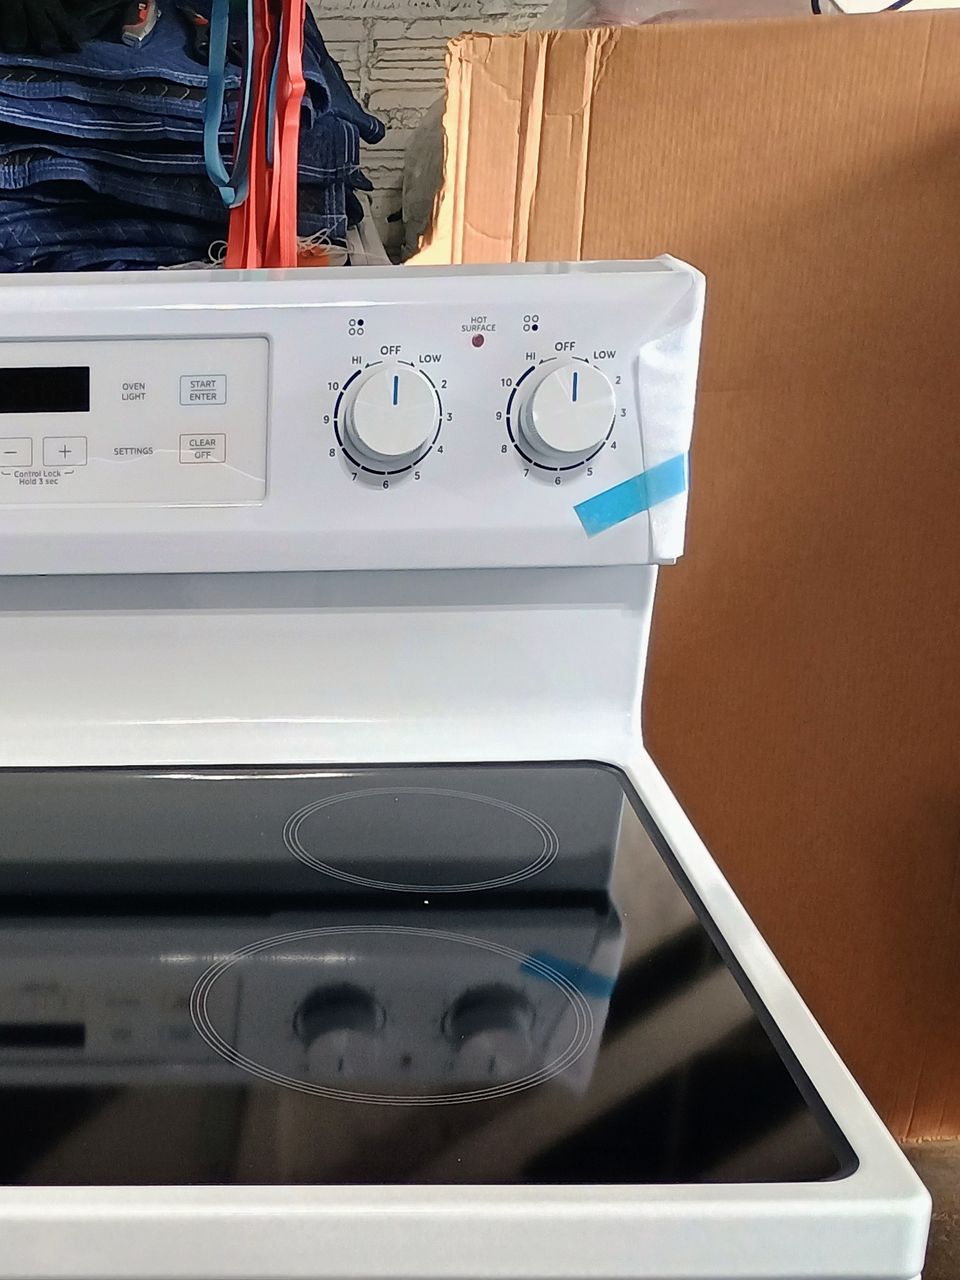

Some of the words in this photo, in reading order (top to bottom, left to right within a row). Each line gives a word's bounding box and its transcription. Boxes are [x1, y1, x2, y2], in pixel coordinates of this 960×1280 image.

[471, 316, 487, 324] HOT
[461, 324, 496, 333] SURFACE
[380, 345, 401, 356] OFF
[555, 342, 576, 352] OFF
[419, 354, 442, 364] LOW
[525, 352, 536, 361] HI
[594, 350, 617, 360] LOW
[352, 356, 362, 365] HI
[190, 380, 216, 389] START
[441, 380, 448, 389] 2
[501, 378, 513, 388] 10
[615, 376, 621, 385] 2
[122, 383, 146, 391] OVEN
[328, 382, 340, 391] 10
[121, 393, 147, 401] LIGHT
[190, 393, 217, 401] ENTER
[446, 413, 453, 422] 3
[495, 412, 502, 421] 9
[620, 408, 627, 418] 3
[323, 415, 330, 425] 9
[189, 439, 216, 447] CLEAR
[610, 441, 617, 450] 4
[114, 447, 154, 456] SETTINGS
[329, 448, 336, 458] 8
[437, 445, 444, 455] 4
[501, 445, 508, 454] 8
[14, 470, 42, 478] Control
[43, 470, 61, 478] Lock
[351, 472, 358, 482] 7
[414, 471, 421, 481] 5
[523, 468, 530, 478] 7
[586, 468, 593, 477] 5
[20, 478, 37, 486] Hold
[382, 480, 389, 490] 6
[555, 477, 561, 486] 6
